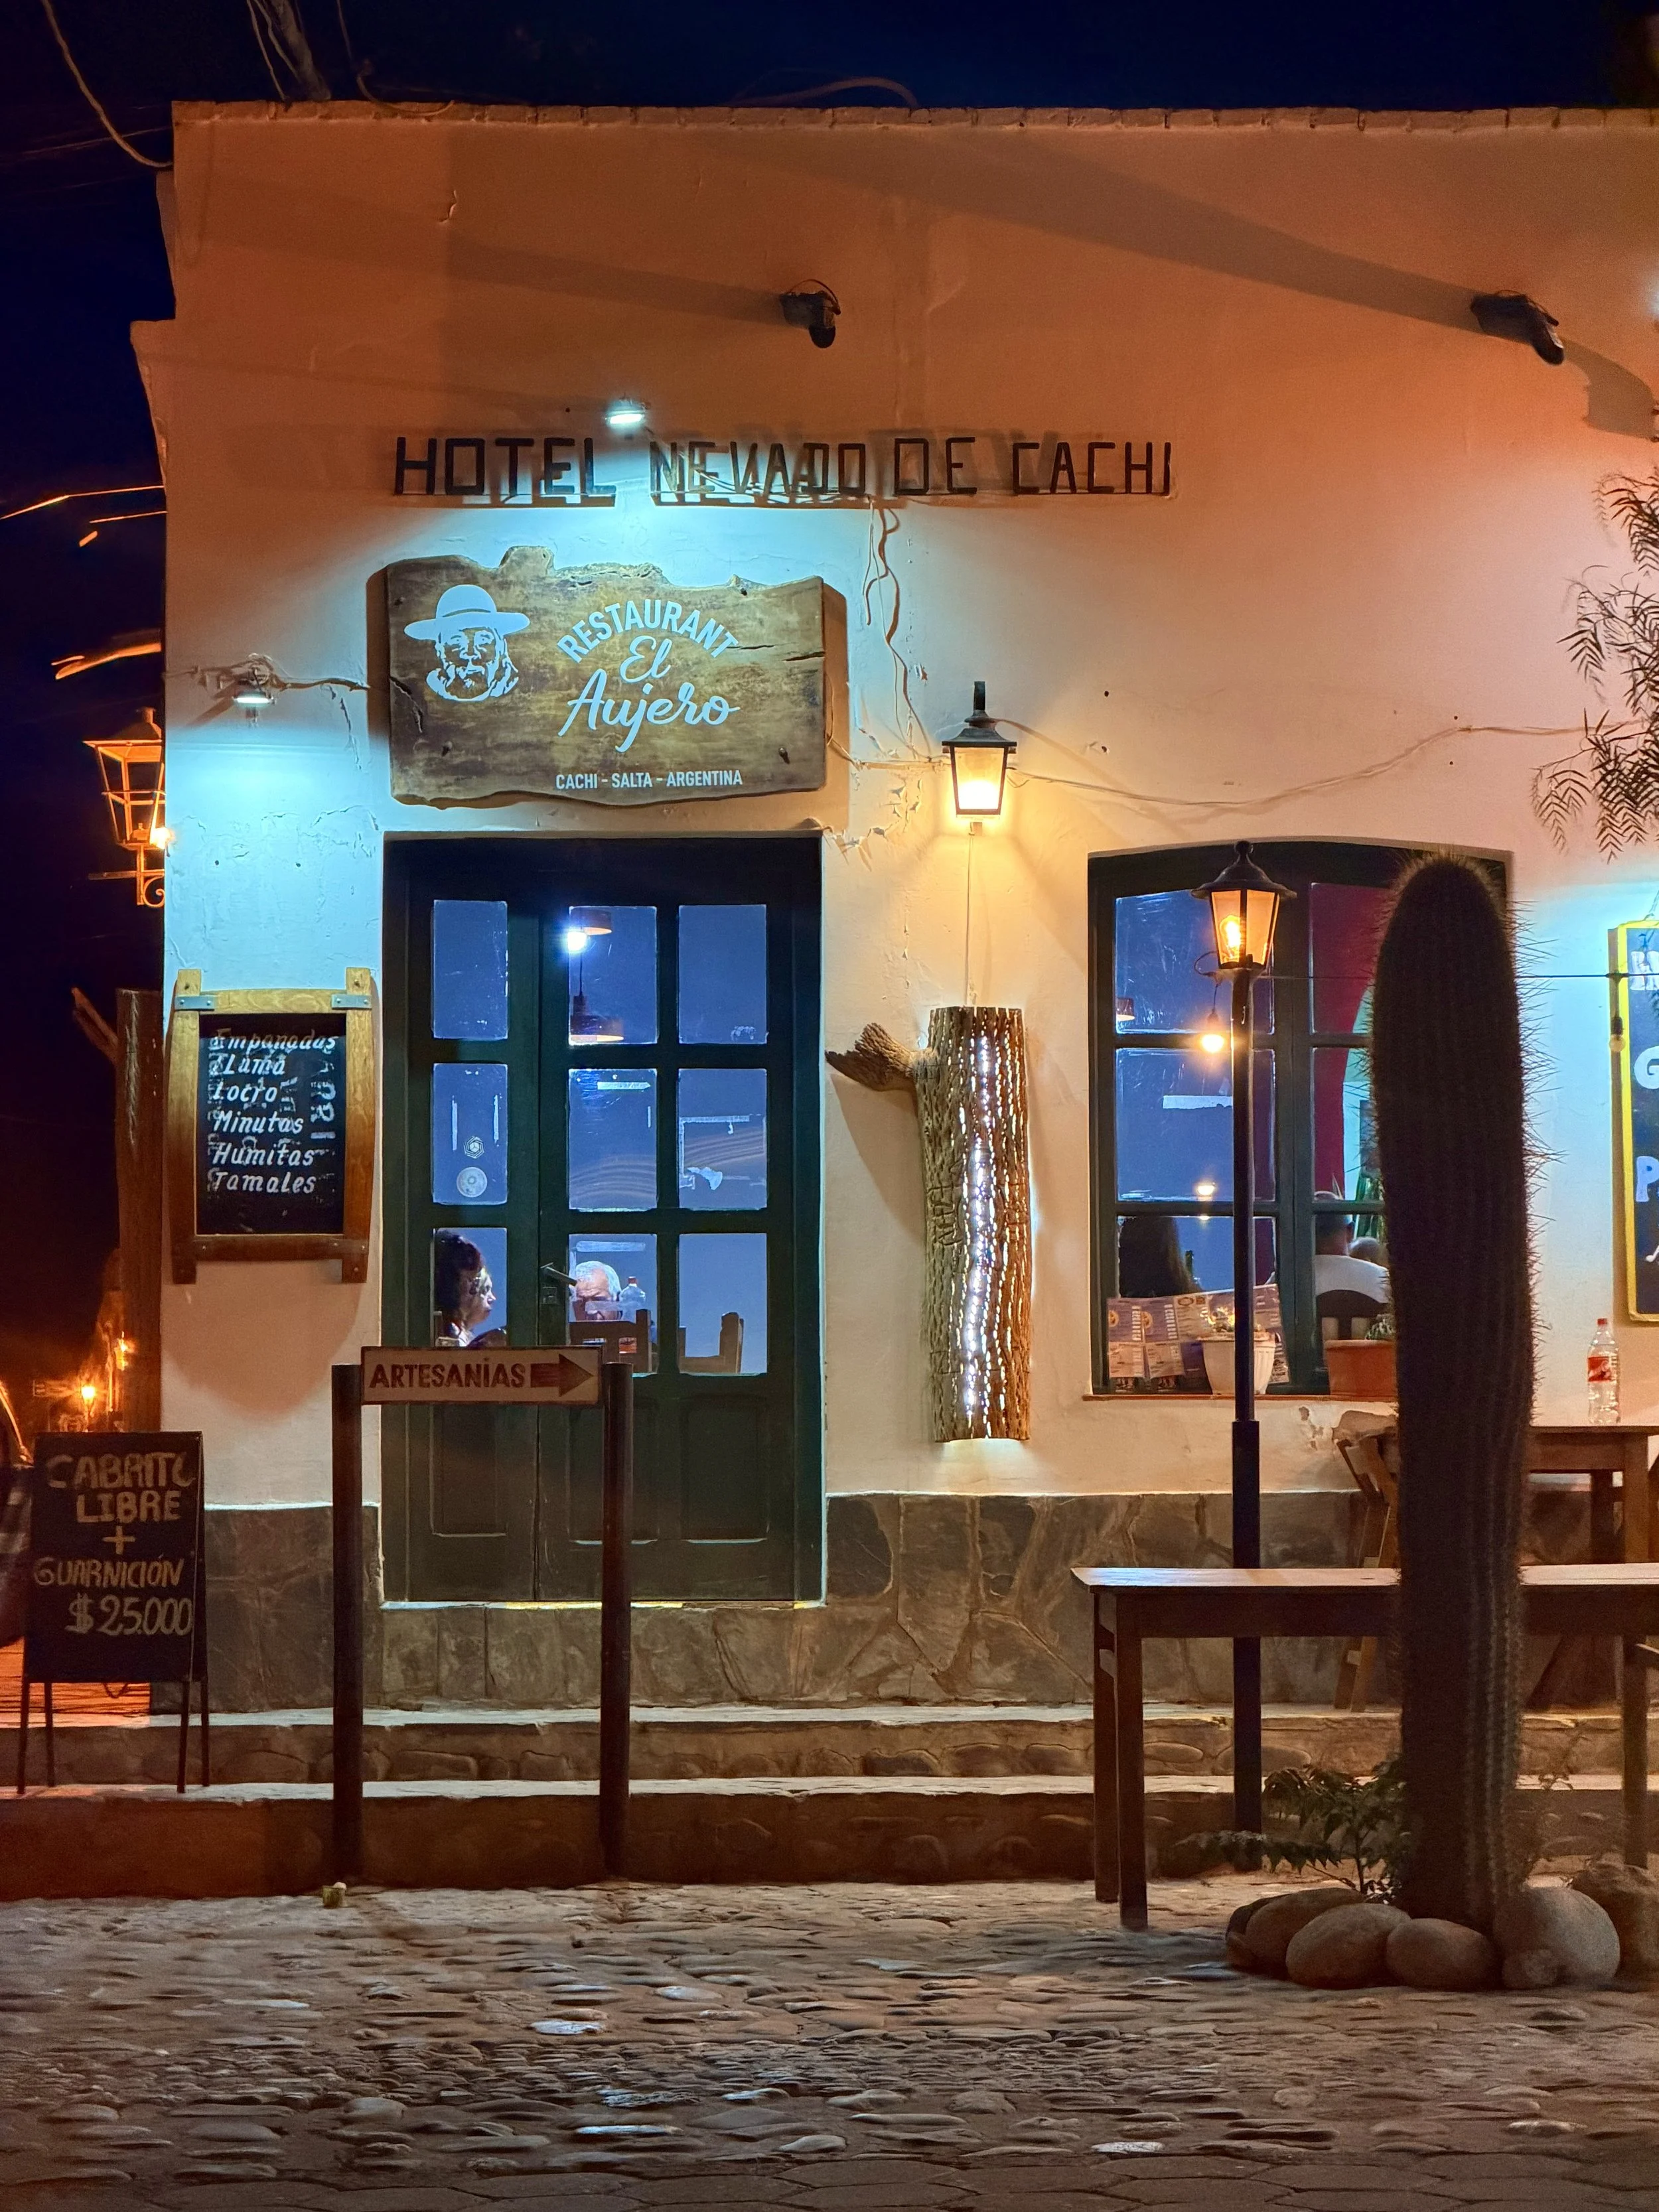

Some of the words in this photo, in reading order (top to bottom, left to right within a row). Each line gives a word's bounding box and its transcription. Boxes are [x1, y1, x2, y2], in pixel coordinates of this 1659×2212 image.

[394, 437, 616, 497] HOTEL
[650, 441, 866, 497] NEVADO
[894, 437, 977, 495] DE
[1013, 442, 1172, 496] CACHI
[557, 599, 739, 663] RESTAURANT
[619, 635, 673, 683] El
[557, 668, 741, 753] Aujero
[555, 773, 597, 790] CACHI
[611, 772, 652, 788] SALTA
[666, 770, 743, 787] ARGENTINA
[212, 1080, 278, 1103] Locro
[213, 1109, 305, 1135] Minutas
[212, 1141, 316, 1166] Humitas
[214, 1171, 317, 1194] Tamales
[369, 1357, 526, 1389] ARTESANÍAS
[76, 1489, 182, 1523] LIBRE
